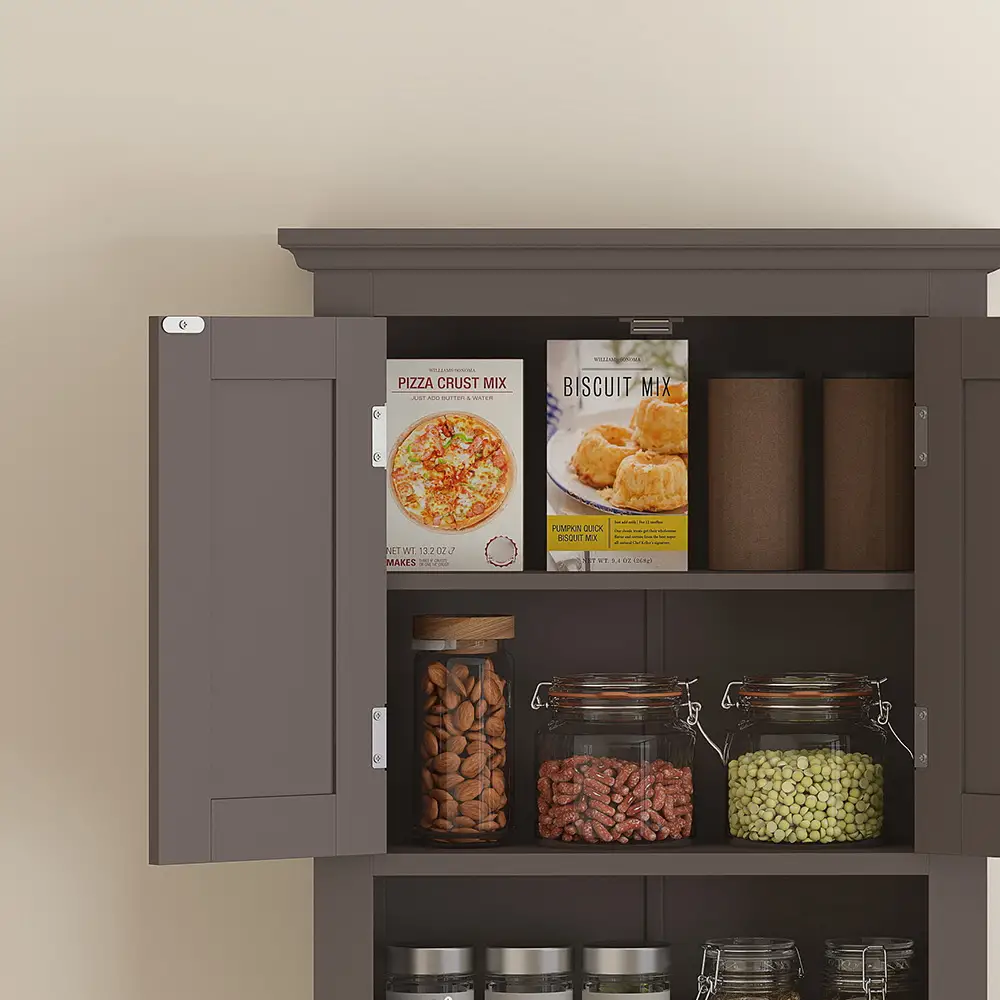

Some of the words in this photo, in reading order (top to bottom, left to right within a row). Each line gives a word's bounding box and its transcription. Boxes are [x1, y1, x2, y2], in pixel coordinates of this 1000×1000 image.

[398, 377, 434, 389] PIZZA
[437, 377, 480, 389] CRUST
[483, 377, 507, 389] MIX
[563, 376, 632, 397] BISCUIT
[642, 376, 671, 397] MIX
[552, 525, 582, 533] PUMPKIN
[583, 525, 604, 533] QUICK
[585, 534, 598, 542] MIX
[386, 547, 402, 555] NET
[402, 547, 417, 555] WT.
[419, 547, 435, 555] 13.2
[436, 547, 446, 555] OZ
[386, 558, 417, 567] MAKES
